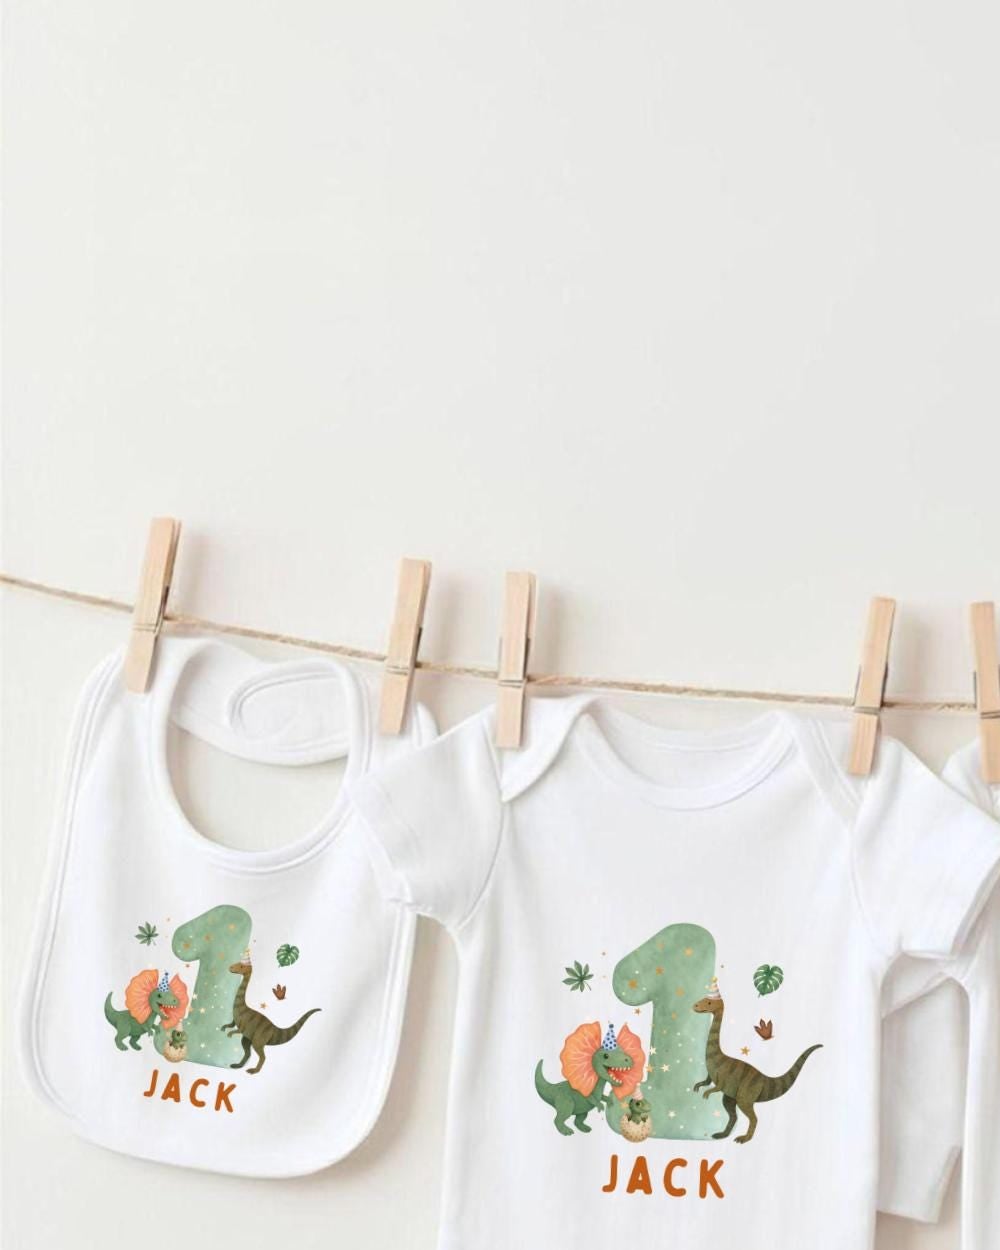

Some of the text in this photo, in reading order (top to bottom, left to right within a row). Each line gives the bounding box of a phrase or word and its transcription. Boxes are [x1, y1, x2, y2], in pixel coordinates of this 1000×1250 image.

[153, 905, 254, 1067] 1
[606, 922, 728, 1142] 1
[143, 1069, 237, 1114] JACK
[601, 1153, 727, 1200] JACK
